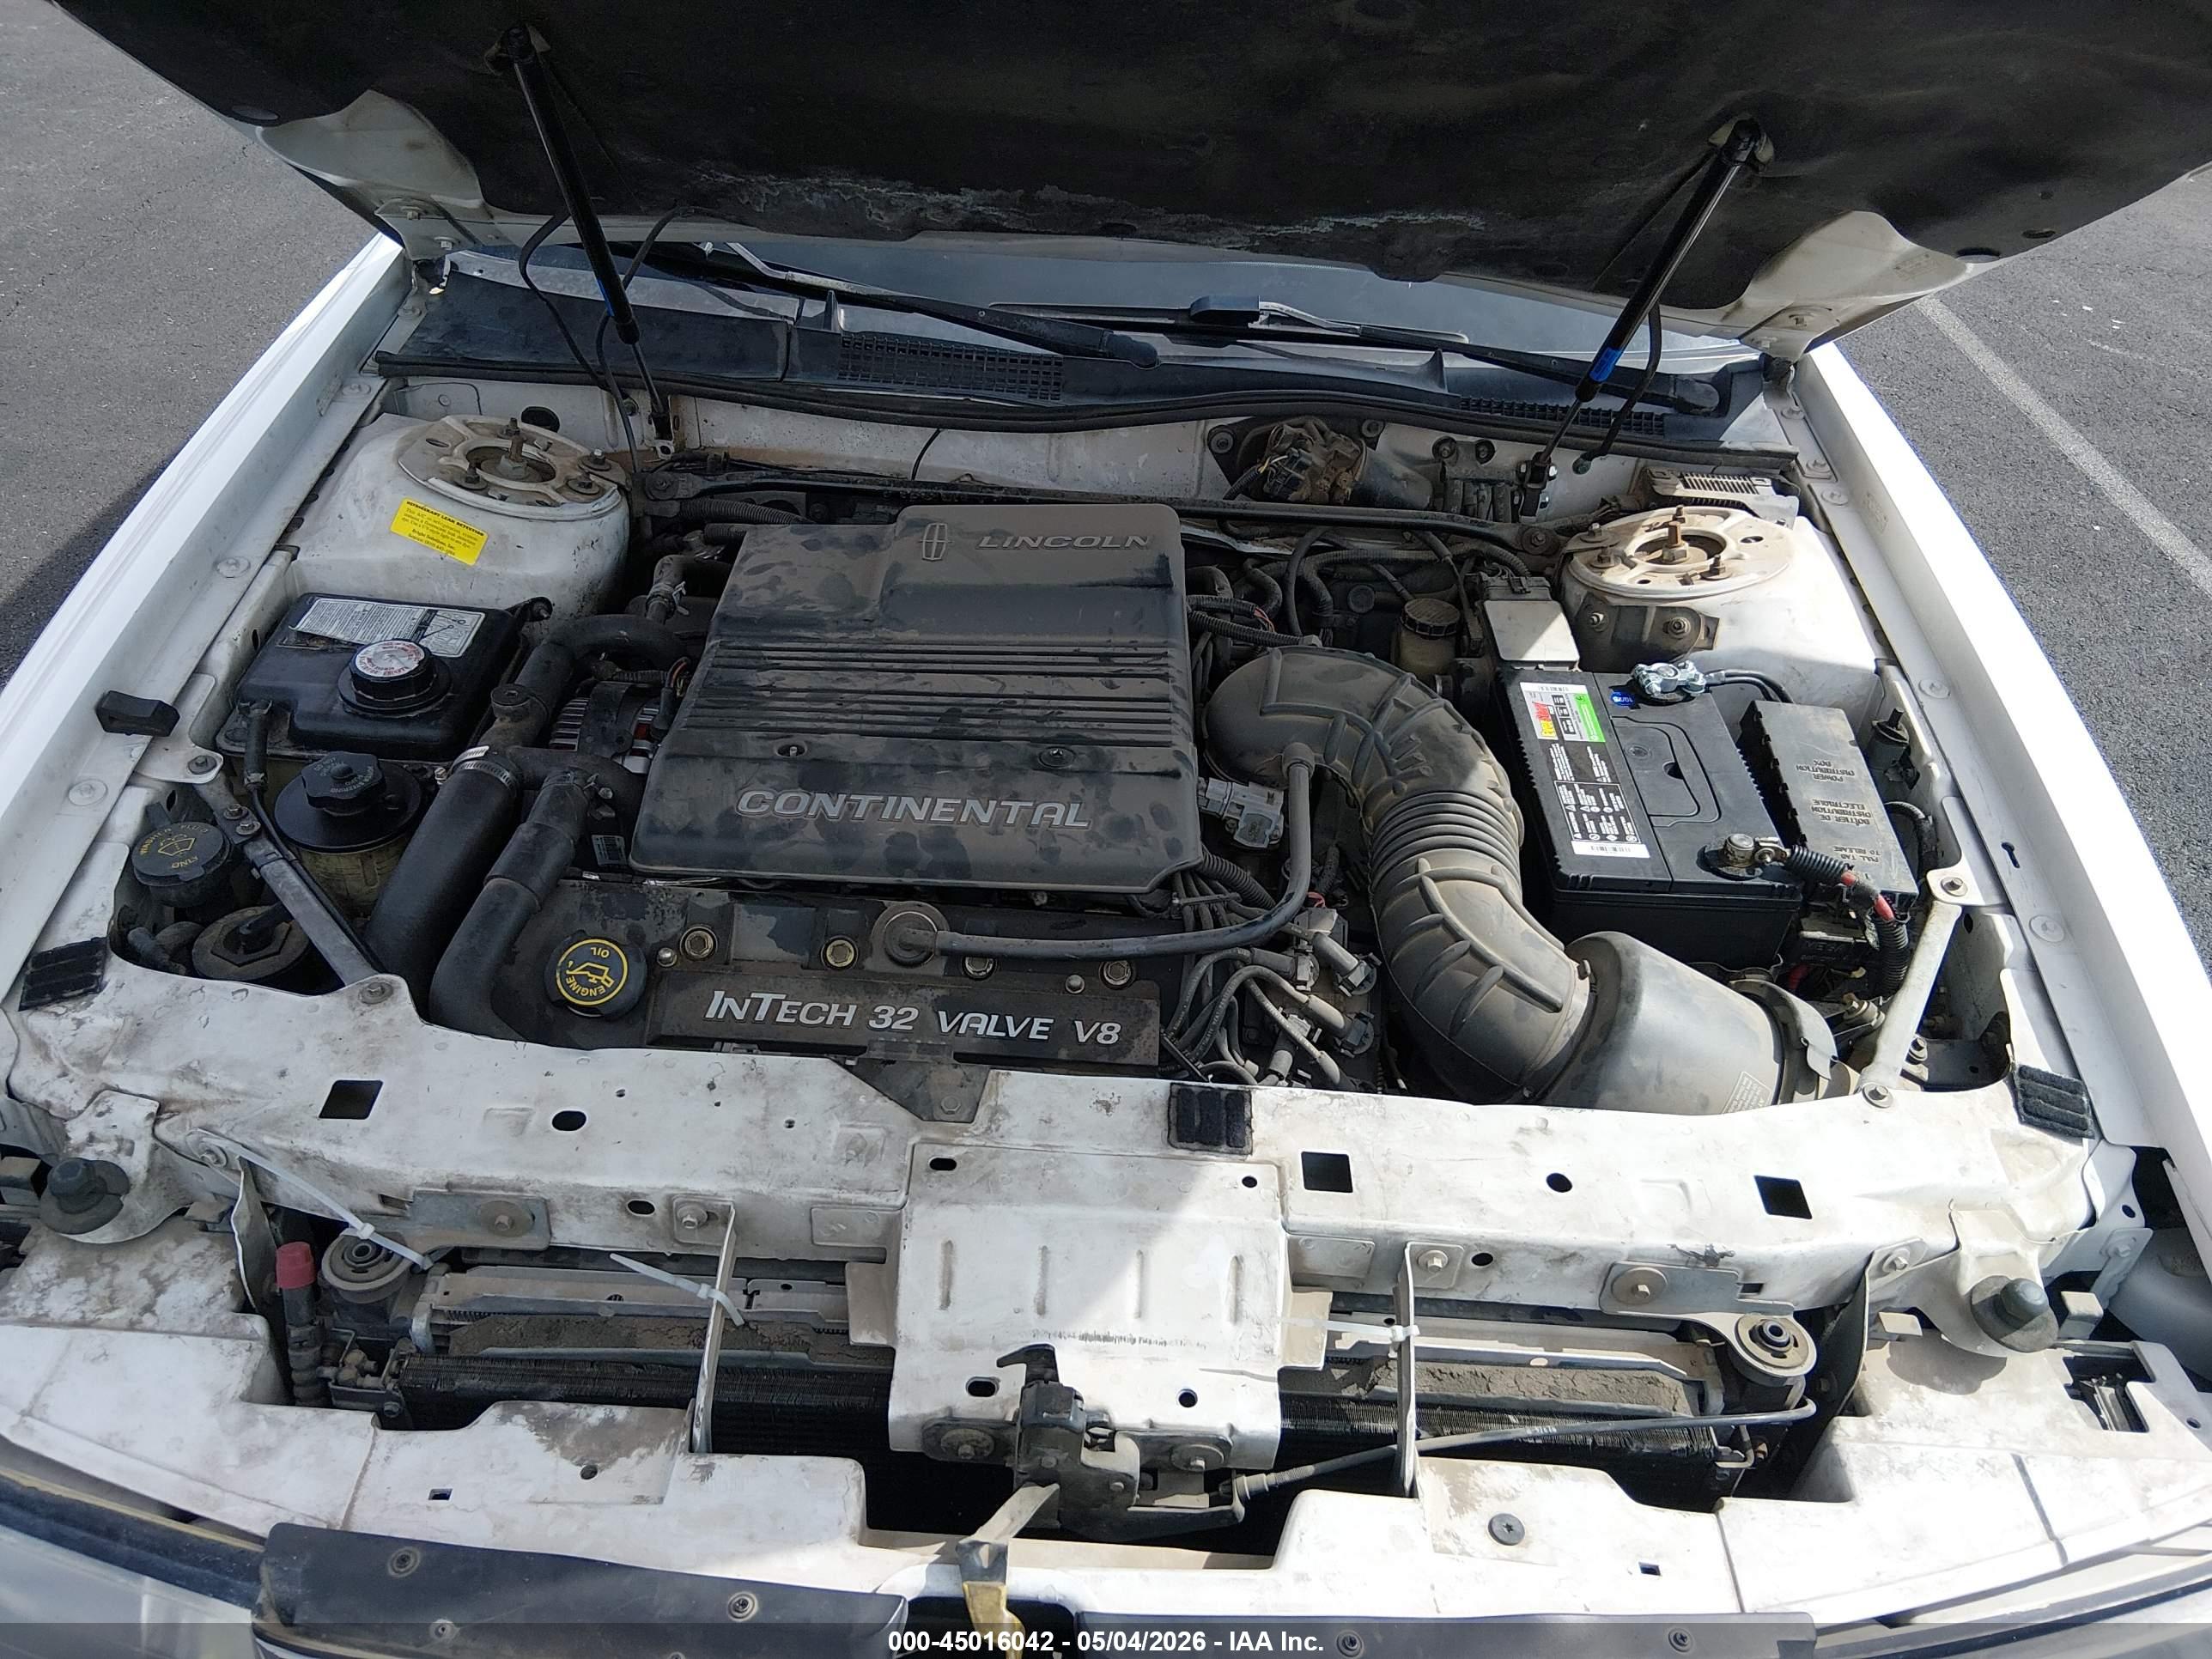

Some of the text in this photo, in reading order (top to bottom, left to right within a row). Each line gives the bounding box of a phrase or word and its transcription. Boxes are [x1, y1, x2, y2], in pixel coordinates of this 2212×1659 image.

[977, 535, 1150, 550] LINCOLN
[1796, 764, 1856, 777] DISTRIBUTION
[1813, 773, 1844, 782] POWER
[737, 790, 1091, 829] CONTINENTAL
[1811, 806, 1871, 818] DISTRIBUTION
[171, 856, 199, 869] ONLY
[590, 946, 610, 958] OIL
[566, 975, 606, 997] ENGINE
[868, 1005, 920, 1031] 32
[937, 1010, 1055, 1041] VALVE
[1073, 1020, 1123, 1046] V8
